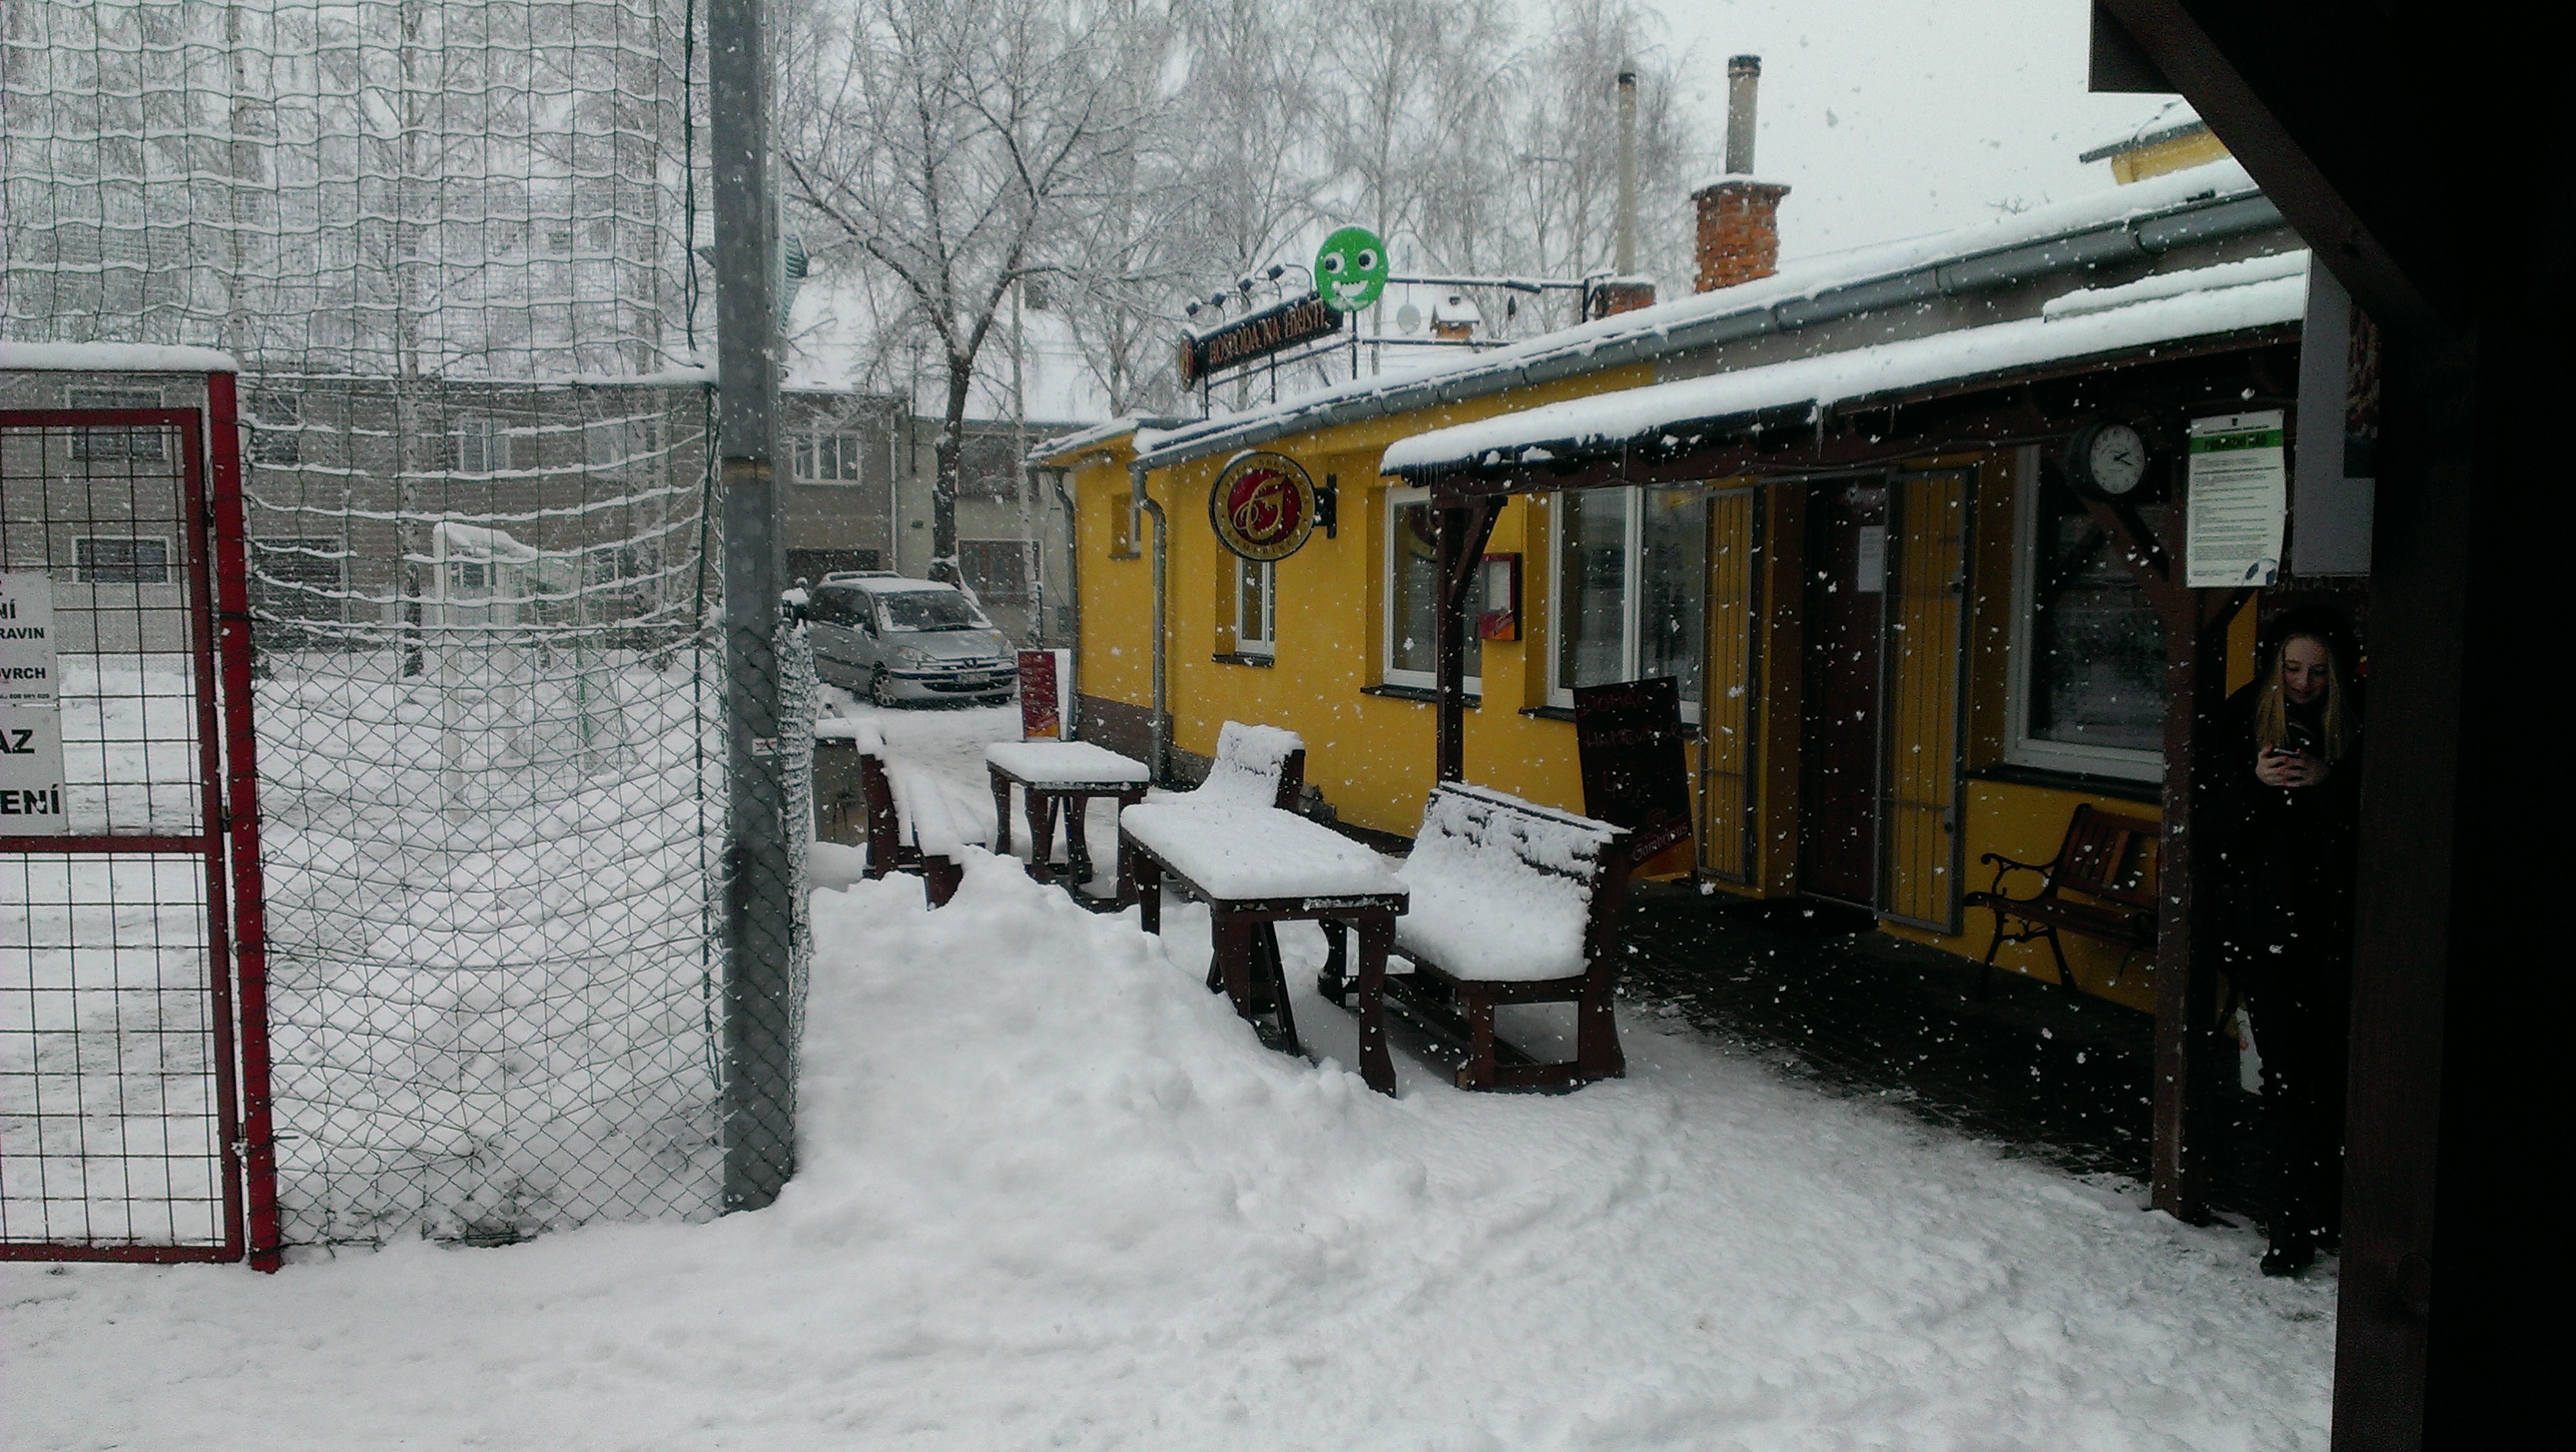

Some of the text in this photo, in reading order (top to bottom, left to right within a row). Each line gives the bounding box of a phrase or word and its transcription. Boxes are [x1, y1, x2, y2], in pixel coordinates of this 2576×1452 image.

[1209, 324, 1263, 365] HOSPODA
[1263, 316, 1282, 347] NA
[0, 666, 47, 679] VRCH
[0, 783, 61, 814] ENÍ
